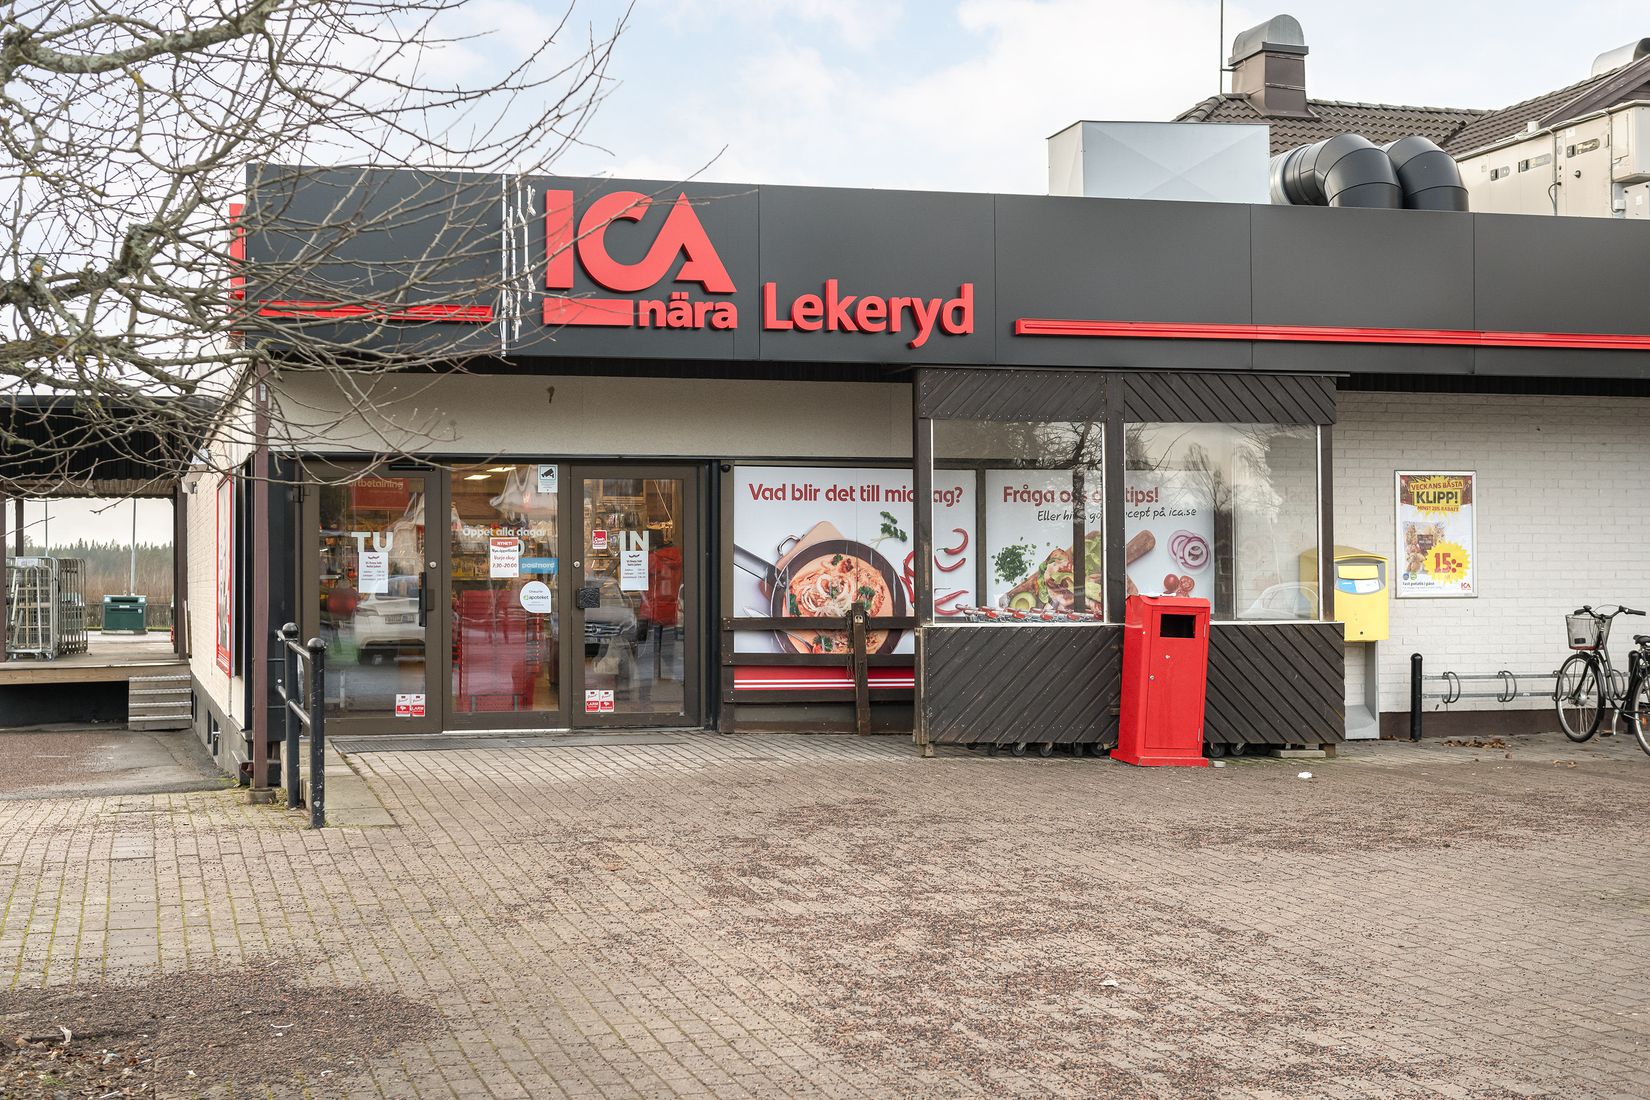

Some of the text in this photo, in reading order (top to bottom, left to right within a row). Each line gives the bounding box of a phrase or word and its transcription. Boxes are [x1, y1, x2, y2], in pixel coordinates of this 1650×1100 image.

[546, 189, 737, 293] ICA
[638, 292, 738, 329] nära
[764, 279, 974, 348] Lekeryd
[748, 483, 963, 507] Vad blir det till midag?
[1003, 484, 1055, 506] Fråga
[1411, 482, 1442, 490] VECKANS
[1416, 491, 1458, 504] KLIPP!
[1037, 510, 1061, 521] Eller
[1153, 507, 1166, 519] på
[1168, 507, 1197, 517] ica.se
[463, 525, 546, 538] Öppet alla dagar
[619, 531, 649, 551] IN
[351, 532, 393, 552] TU
[1434, 553, 1462, 573] 15:-
